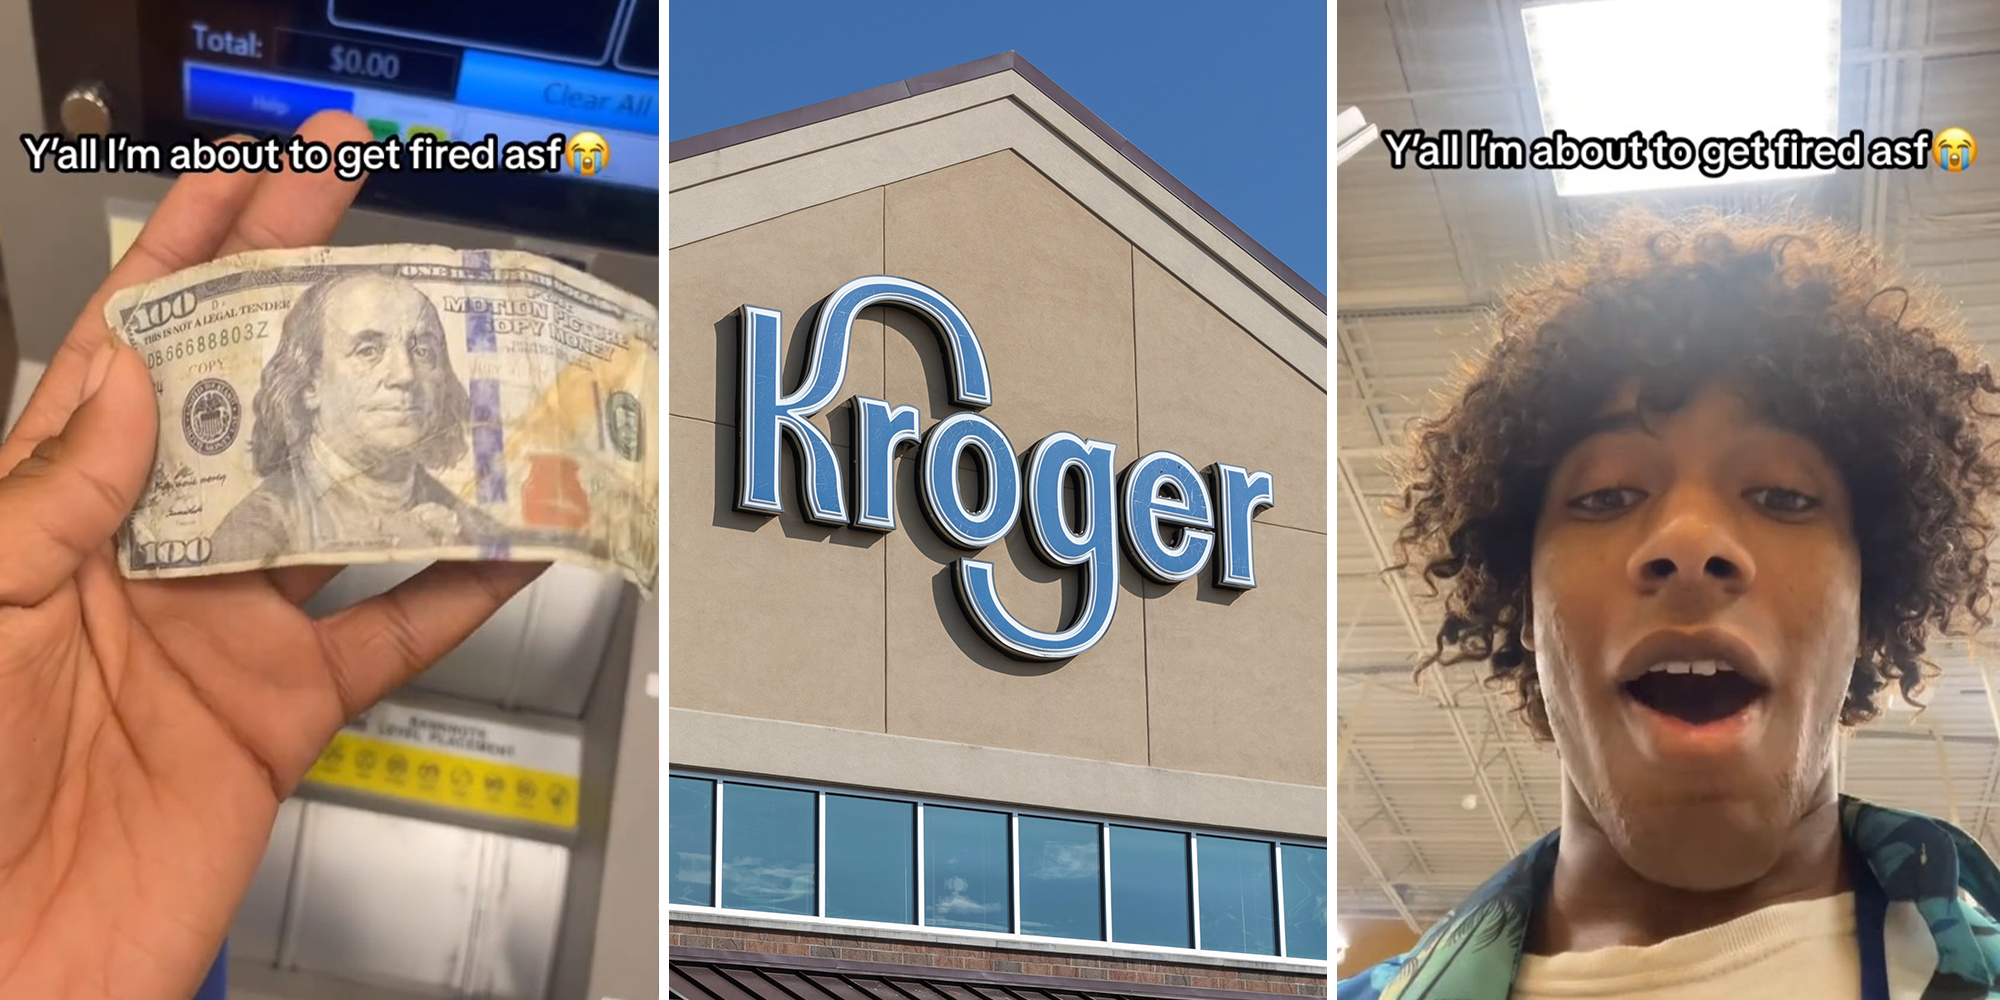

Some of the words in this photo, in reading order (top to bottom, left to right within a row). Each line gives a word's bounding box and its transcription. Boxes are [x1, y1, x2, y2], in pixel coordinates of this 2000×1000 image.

[192, 24, 262, 58] Total:
[329, 45, 399, 79] $0.00
[543, 82, 611, 112] Clear
[617, 92, 654, 117] All
[134, 289, 198, 335] 100
[144, 333, 162, 345] THIS
[162, 329, 172, 339] IS
[172, 321, 193, 335] NOT
[193, 317, 202, 327] A
[202, 306, 238, 325] LEGAL
[240, 300, 291, 316] TENDER
[443, 295, 548, 319] MOTION
[189, 358, 224, 373] COPY
[734, 273, 1275, 661] Kroger
[141, 536, 212, 565] 100
